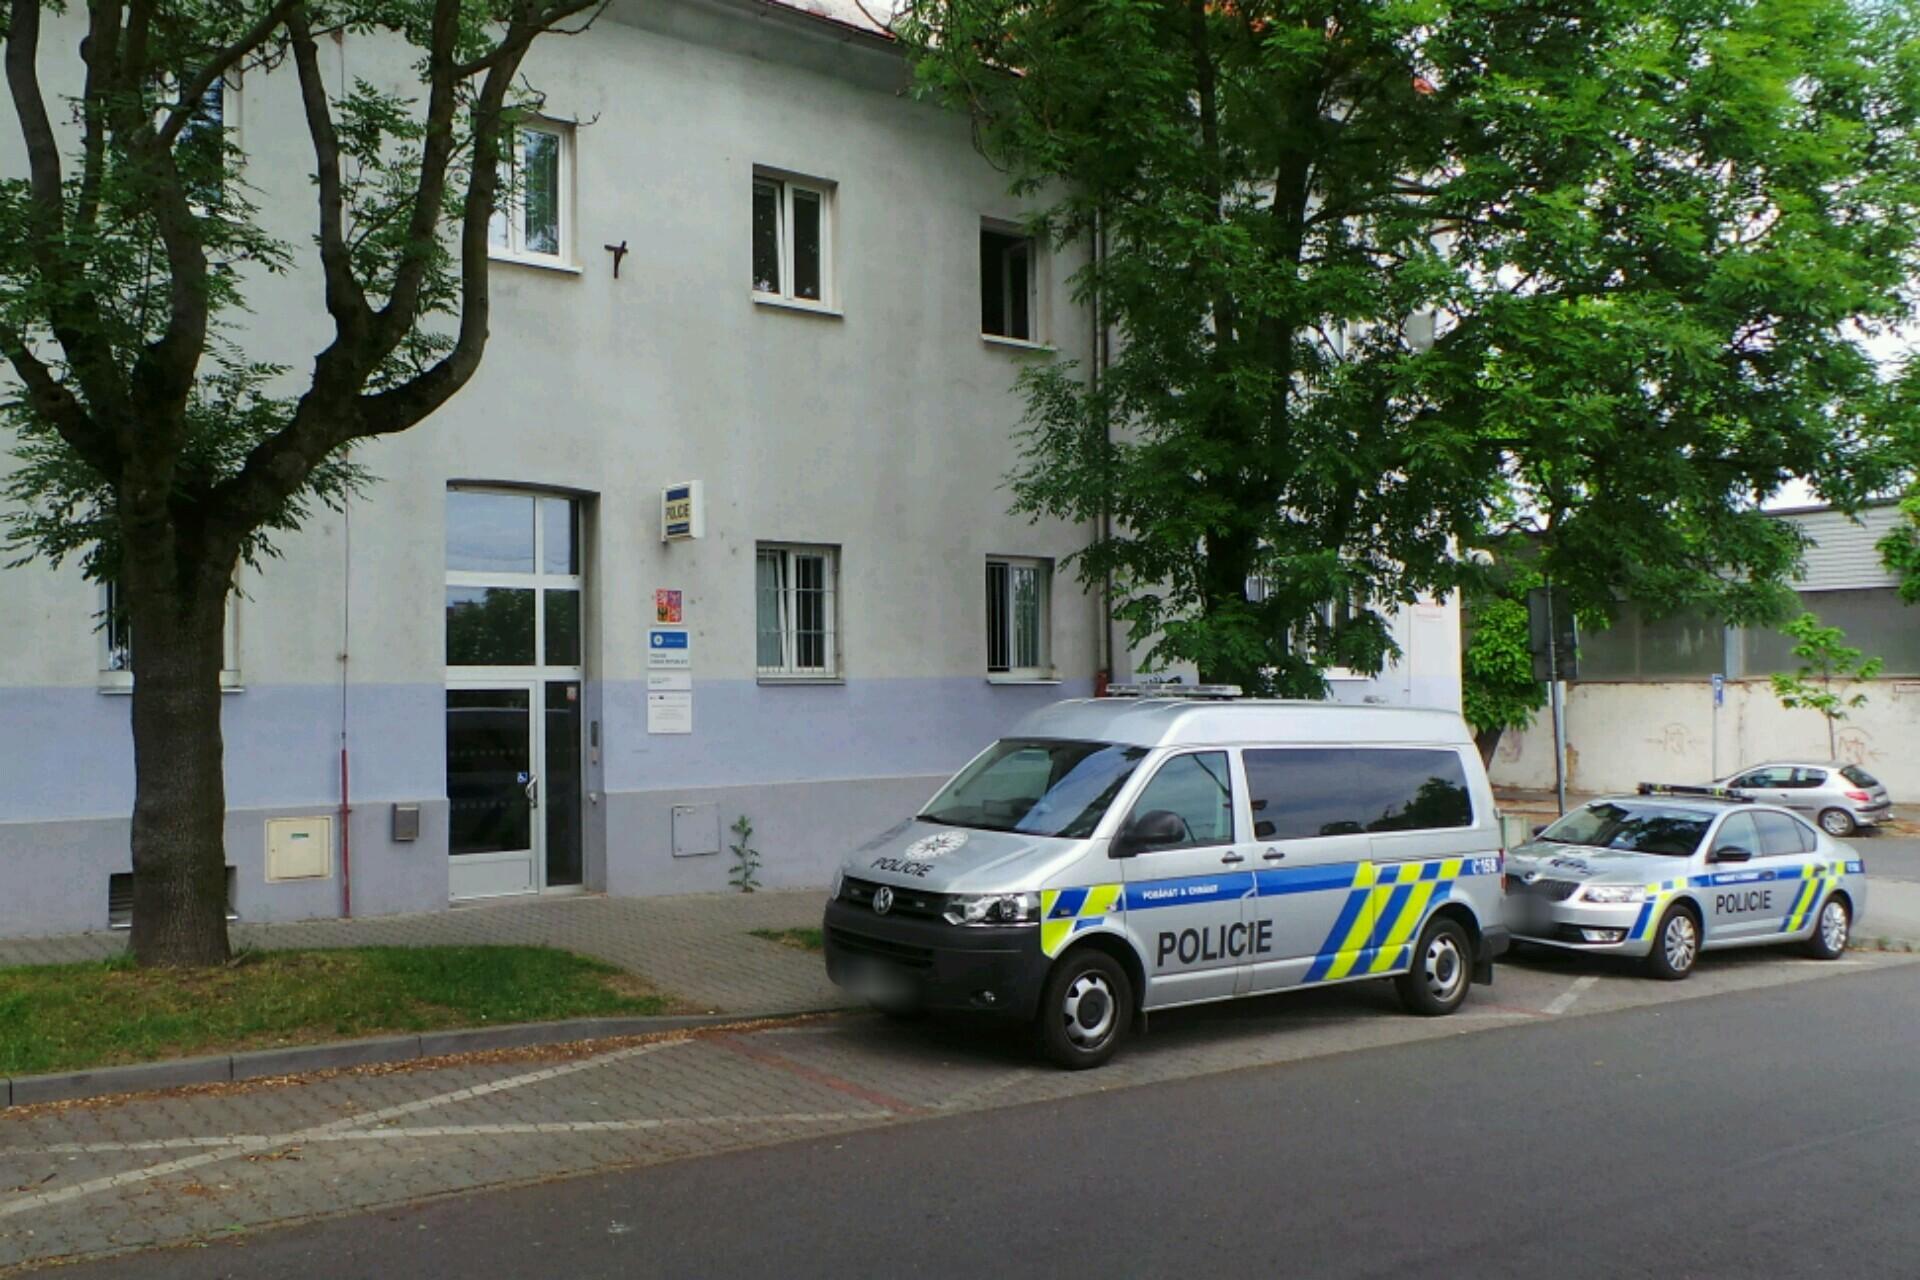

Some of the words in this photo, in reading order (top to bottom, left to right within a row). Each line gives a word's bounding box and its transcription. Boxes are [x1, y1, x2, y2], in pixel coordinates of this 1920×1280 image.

[870, 856, 936, 878] POLICIE
[1715, 890, 1772, 915] POLICIE
[1157, 919, 1273, 967] POLICIE
